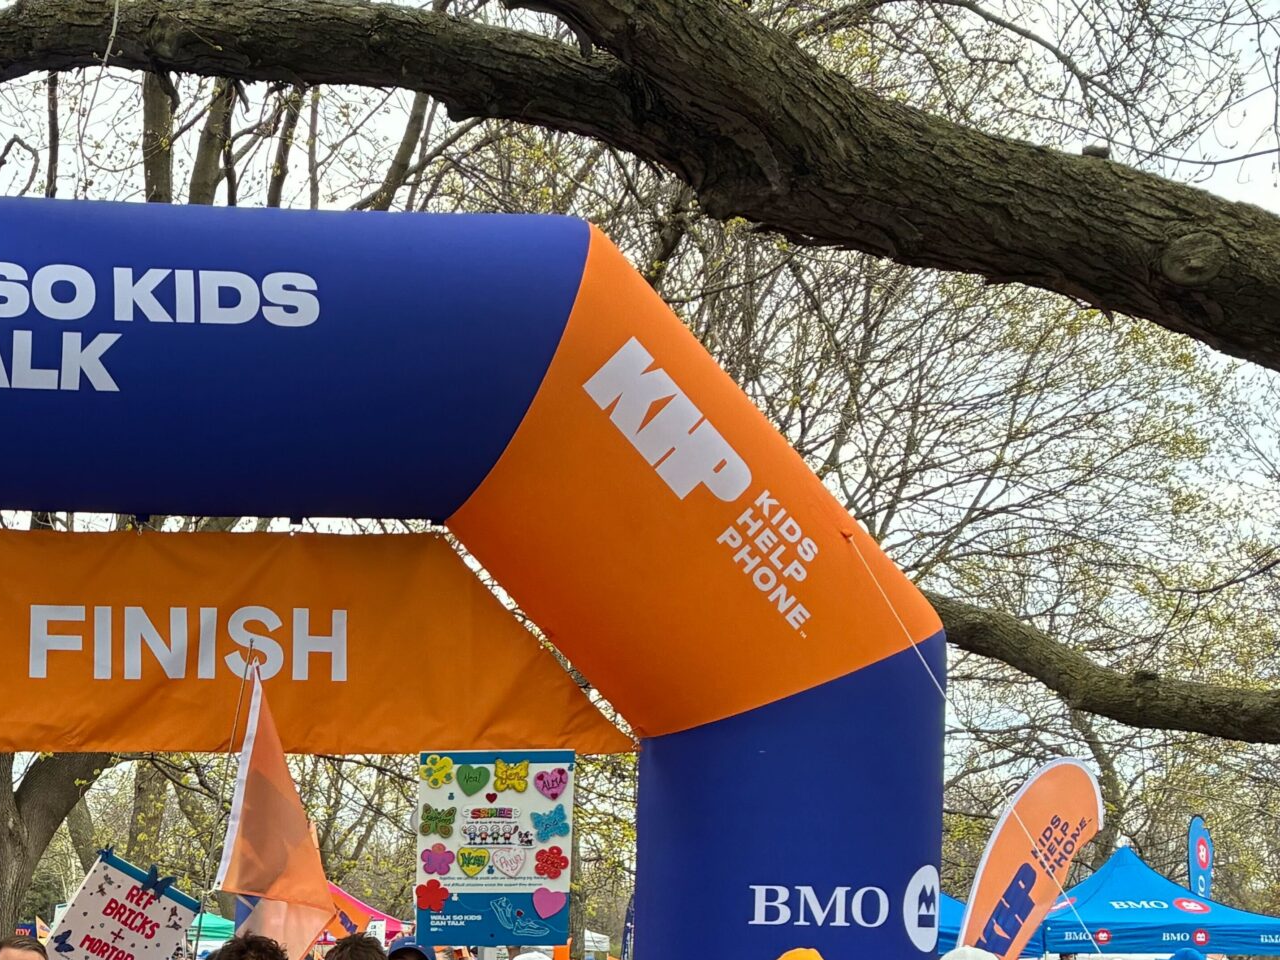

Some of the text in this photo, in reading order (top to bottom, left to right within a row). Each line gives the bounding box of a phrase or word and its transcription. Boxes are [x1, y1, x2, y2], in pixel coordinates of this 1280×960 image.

[114, 267, 320, 327] KIDS
[582, 336, 752, 501] KHP
[736, 509, 808, 584] HELP
[754, 490, 819, 563] KIDS
[29, 605, 348, 682] FINISH
[1031, 815, 1062, 859] KIDS
[1039, 821, 1071, 870] HELP
[102, 898, 161, 940] BRICKS
[125, 885, 157, 910] REF
[749, 885, 889, 927] BMO
[975, 862, 1037, 957] KHP
[1109, 900, 1169, 909] BMO
[1064, 931, 1092, 941] BMO
[1162, 932, 1190, 941] BMO
